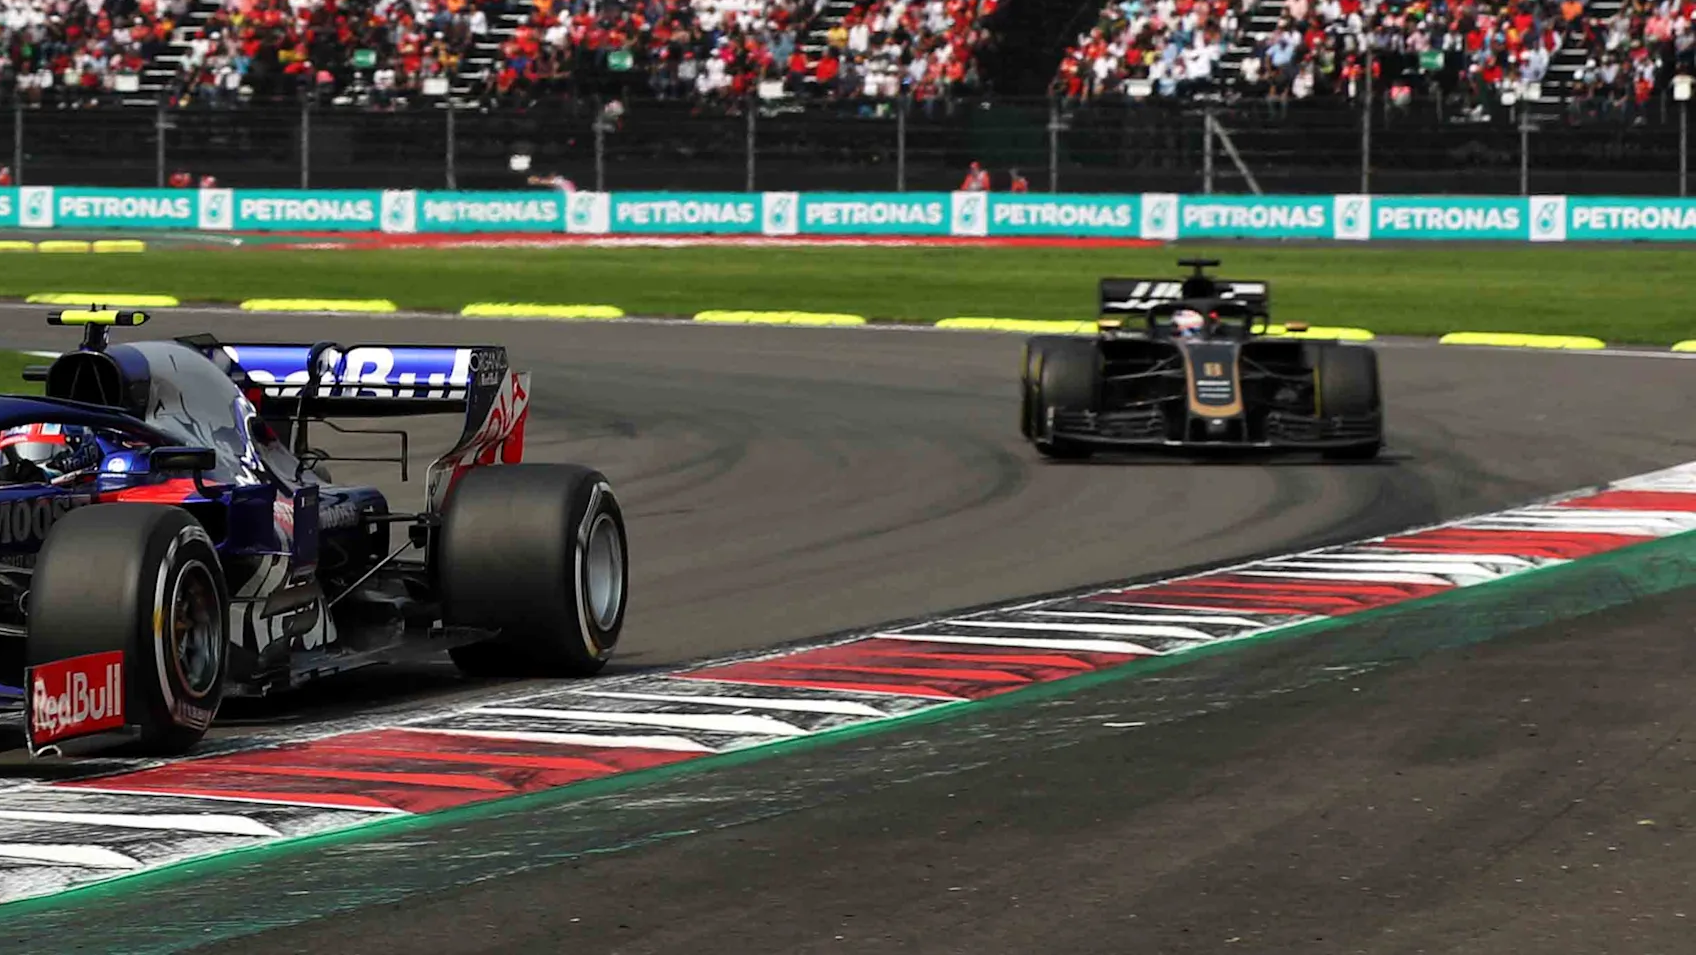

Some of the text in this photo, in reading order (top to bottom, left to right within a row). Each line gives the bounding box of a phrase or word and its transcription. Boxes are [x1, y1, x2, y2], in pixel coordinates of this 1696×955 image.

[60, 197, 190, 218] PETRONAS
[241, 199, 373, 220] PETRONAS
[424, 201, 557, 221] PETRONAS
[617, 201, 754, 223] PETRONAS
[806, 202, 942, 224] PETRONAS
[994, 203, 1131, 226] PETRONAS
[1183, 205, 1325, 228] PETRONAS
[1378, 207, 1520, 229] PETRONAS
